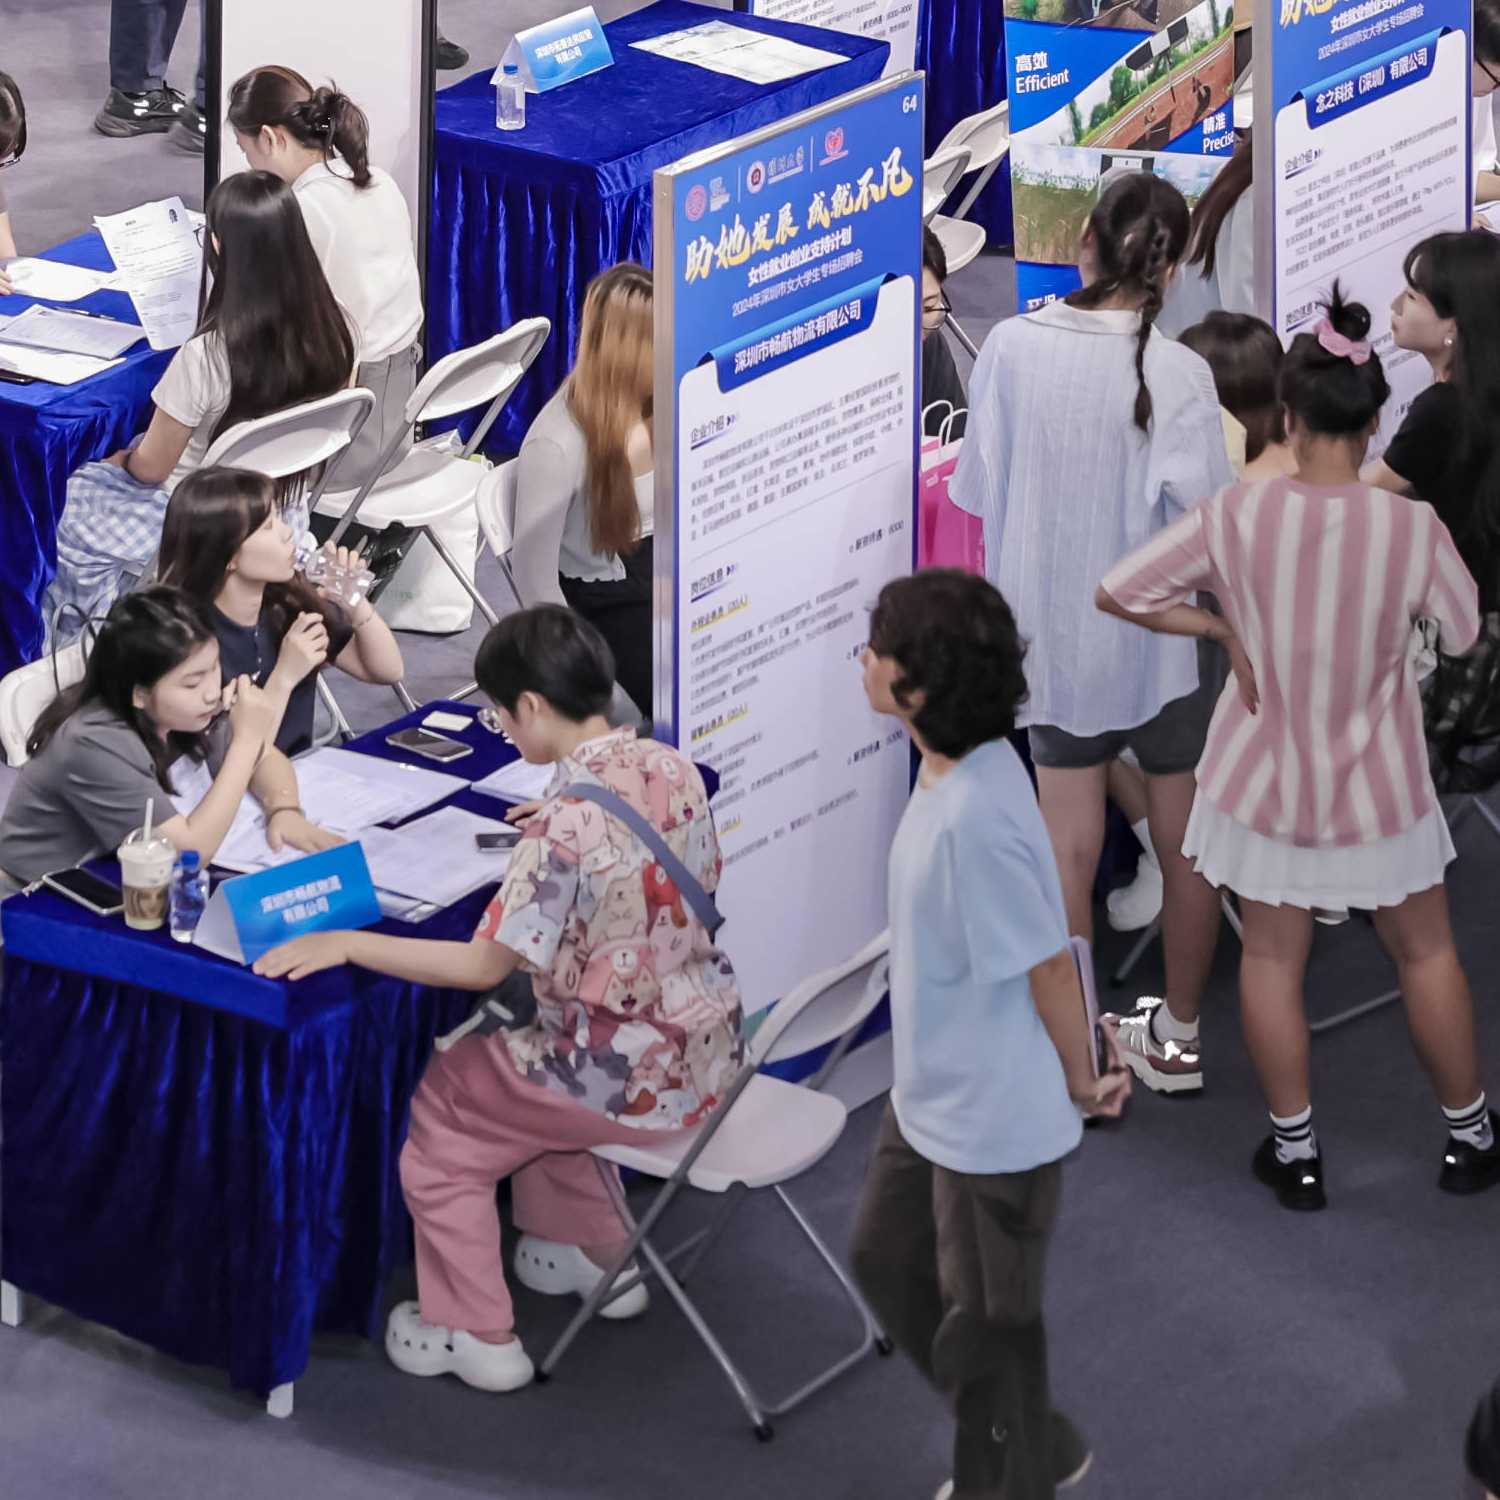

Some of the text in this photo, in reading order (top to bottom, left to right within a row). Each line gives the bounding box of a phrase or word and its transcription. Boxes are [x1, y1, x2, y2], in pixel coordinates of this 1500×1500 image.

[1318, 4, 1424, 60] 2024年深圳市女大学生专场招聘会
[1015, 52, 1048, 73] 高效
[1015, 68, 1069, 94] Efficient
[1315, 48, 1428, 113] 念之科技（深圳）有限公司
[902, 95, 918, 113] 64
[1202, 113, 1226, 136] 精准
[1202, 130, 1235, 154] Precise
[685, 146, 913, 285] 助她发展 成就不凡
[732, 249, 863, 317] 2024年深圳市女大学生专场招聘会
[748, 225, 852, 287] 女性就业创业支持计划
[734, 299, 862, 374] 深圳市畅航物流有限公司
